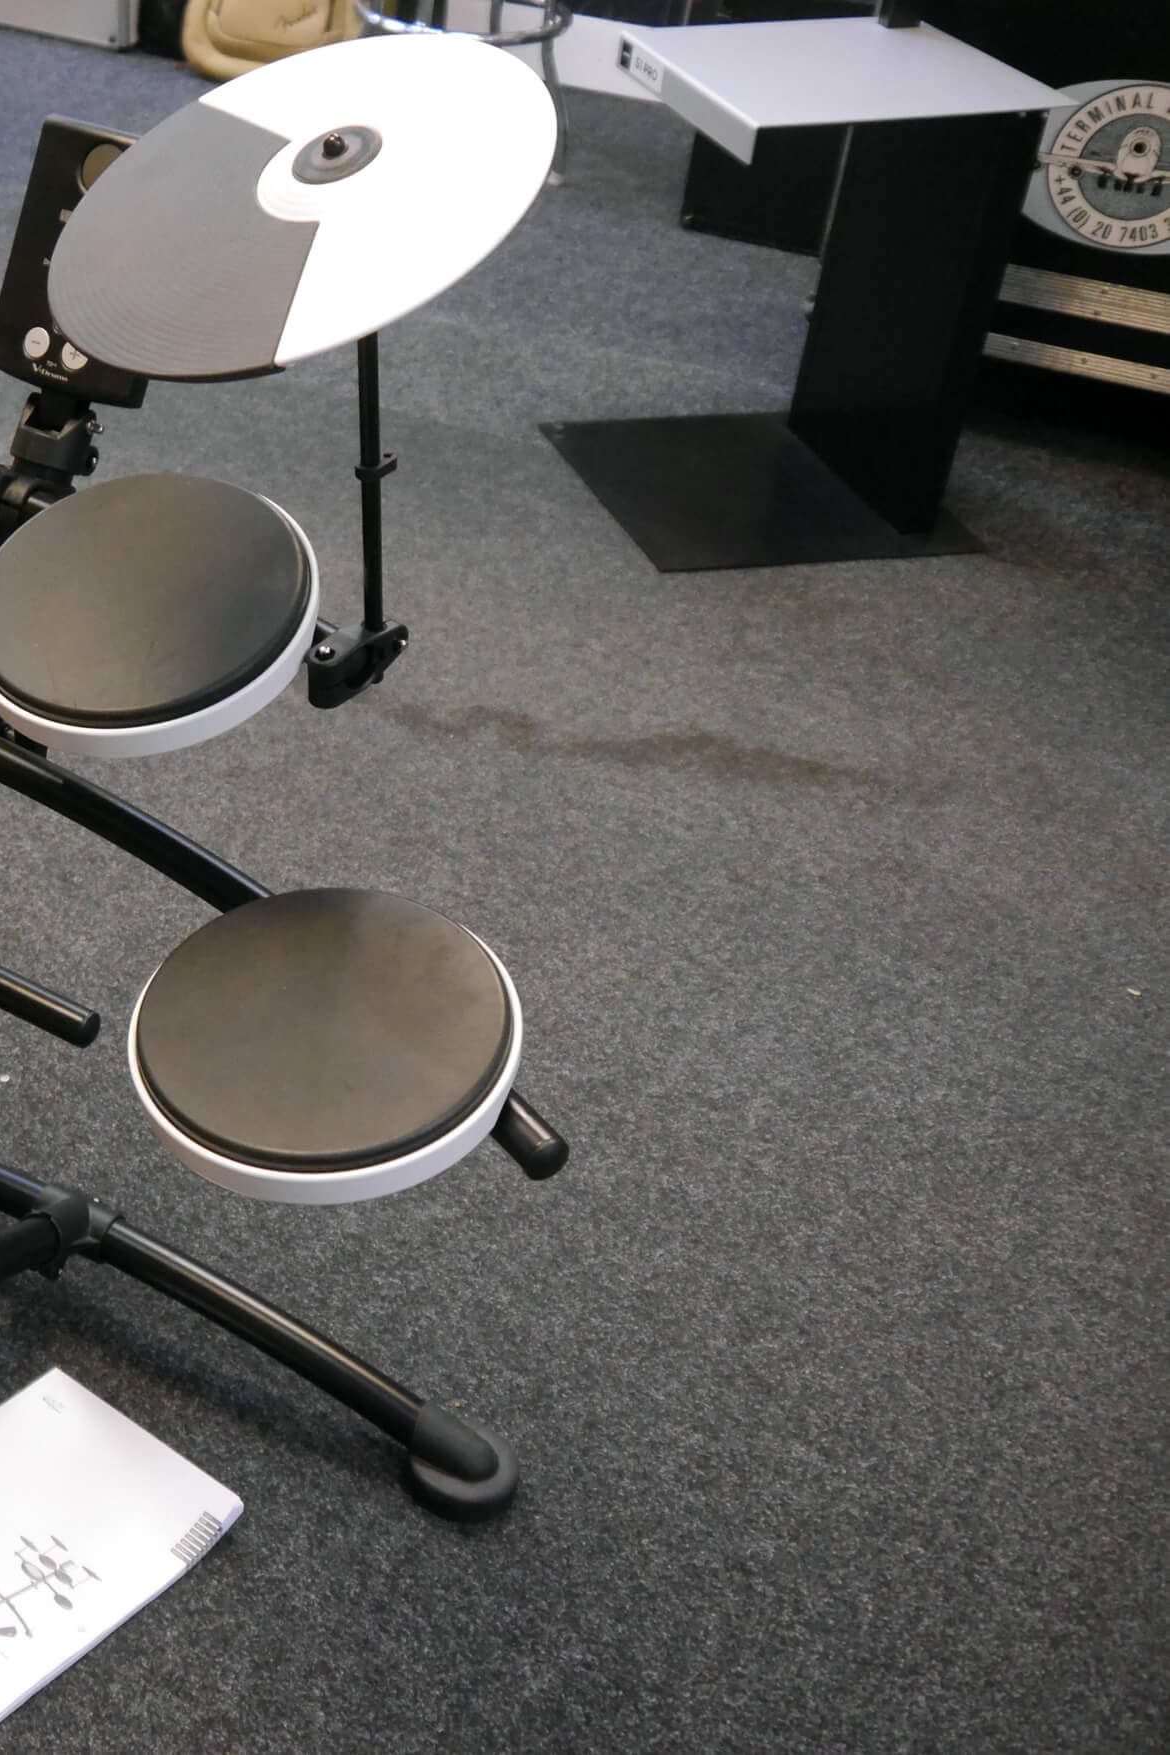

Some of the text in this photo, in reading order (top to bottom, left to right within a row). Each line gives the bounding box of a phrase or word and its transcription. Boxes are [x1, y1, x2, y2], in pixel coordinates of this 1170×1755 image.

[1060, 91, 1155, 152] TERMINAL
[1091, 221, 1112, 240] 20
[1119, 223, 1159, 242] 7403
